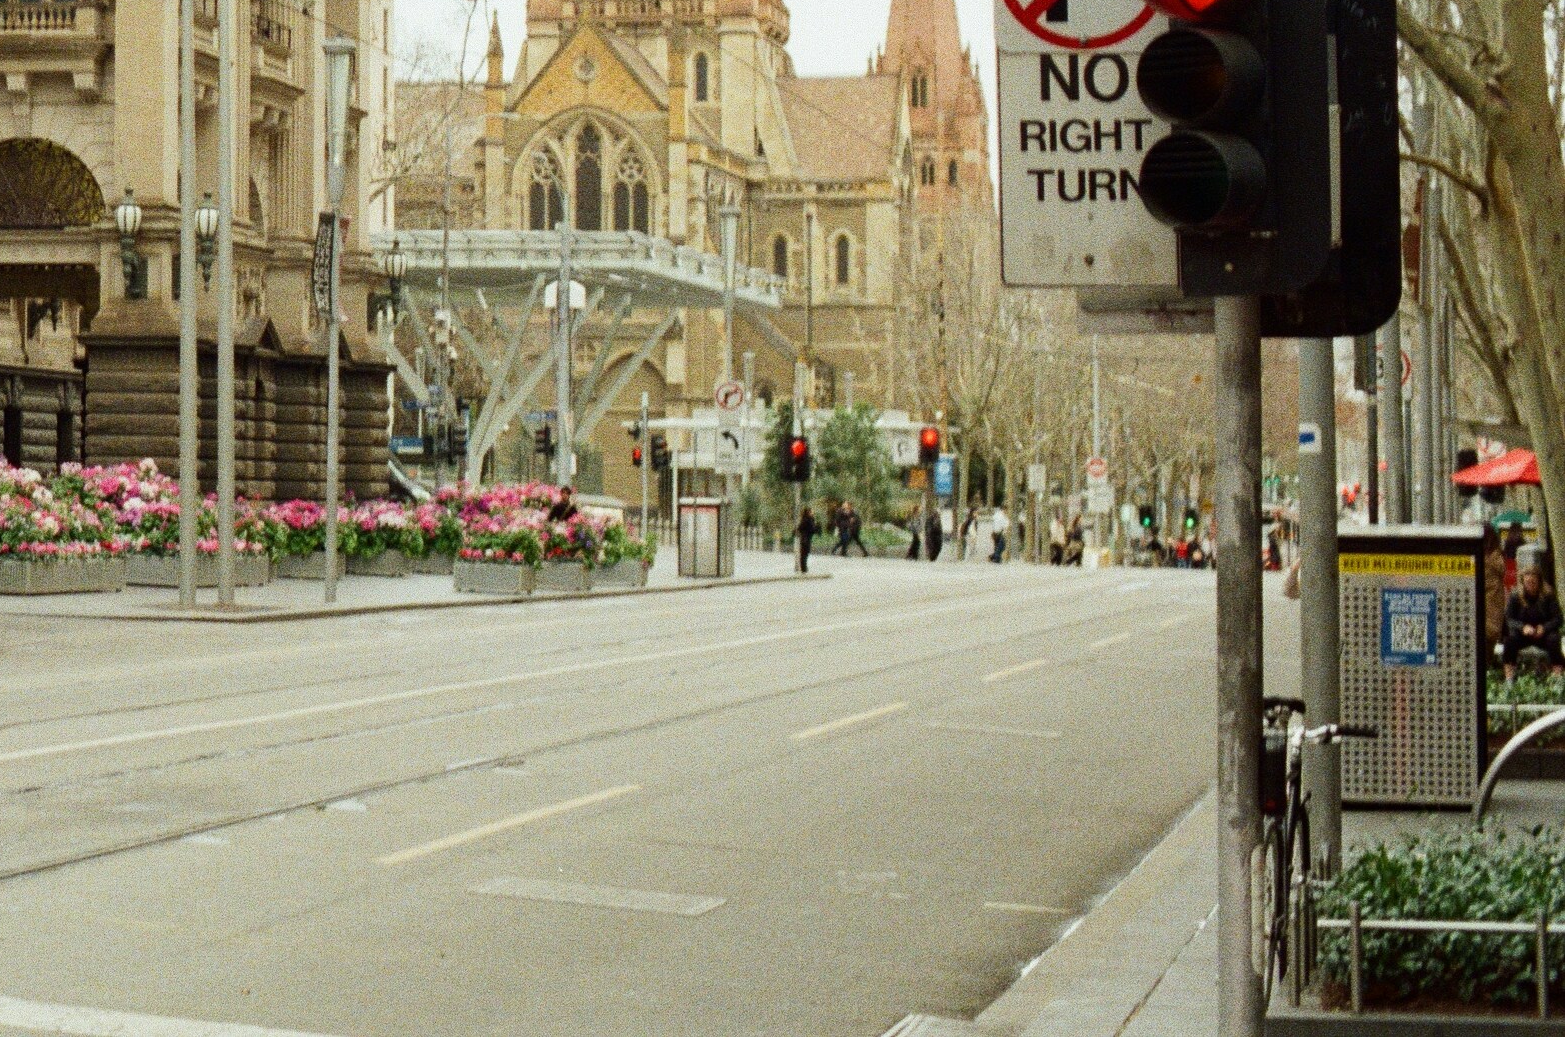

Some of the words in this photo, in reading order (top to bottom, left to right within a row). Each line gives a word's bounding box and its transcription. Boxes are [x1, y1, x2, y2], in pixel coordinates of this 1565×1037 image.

[1040, 53, 1130, 103] NO
[1020, 119, 1152, 154] RIGHT
[1027, 169, 1143, 202] TURN
[1373, 559, 1434, 570] MELBOURNE
[1439, 560, 1471, 571] CLEAN
